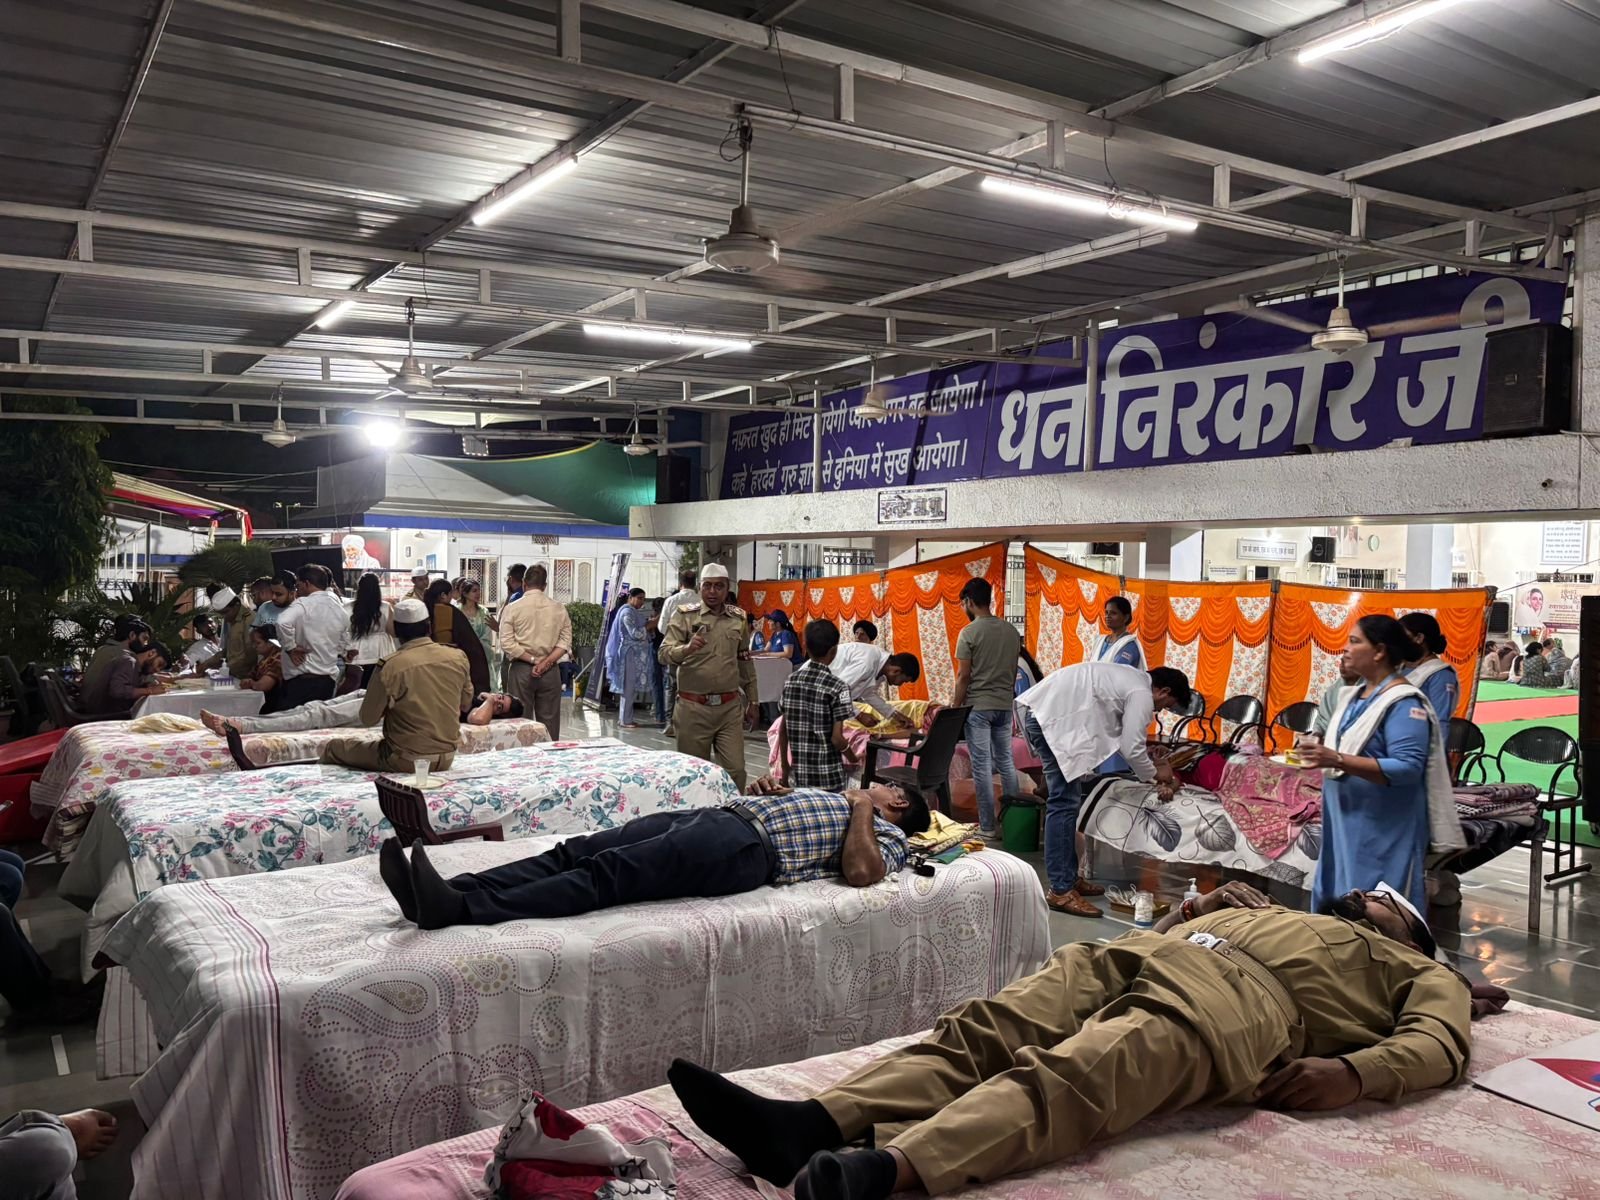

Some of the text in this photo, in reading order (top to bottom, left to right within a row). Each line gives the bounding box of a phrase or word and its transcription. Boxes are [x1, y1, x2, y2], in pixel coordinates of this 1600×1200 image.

[998, 382, 1088, 470] धन
[1099, 320, 1385, 463] निरंकार
[761, 422, 779, 453] खुद
[779, 411, 791, 447] ही
[791, 411, 812, 441] मिट
[813, 398, 848, 436] ायेगी
[731, 463, 748, 496] कहे
[780, 464, 799, 496] गुरु
[799, 462, 816, 491] ज्ञा
[822, 449, 834, 485] से
[833, 446, 871, 490] दुनिया
[871, 441, 885, 478] में
[884, 448, 912, 485] सुख
